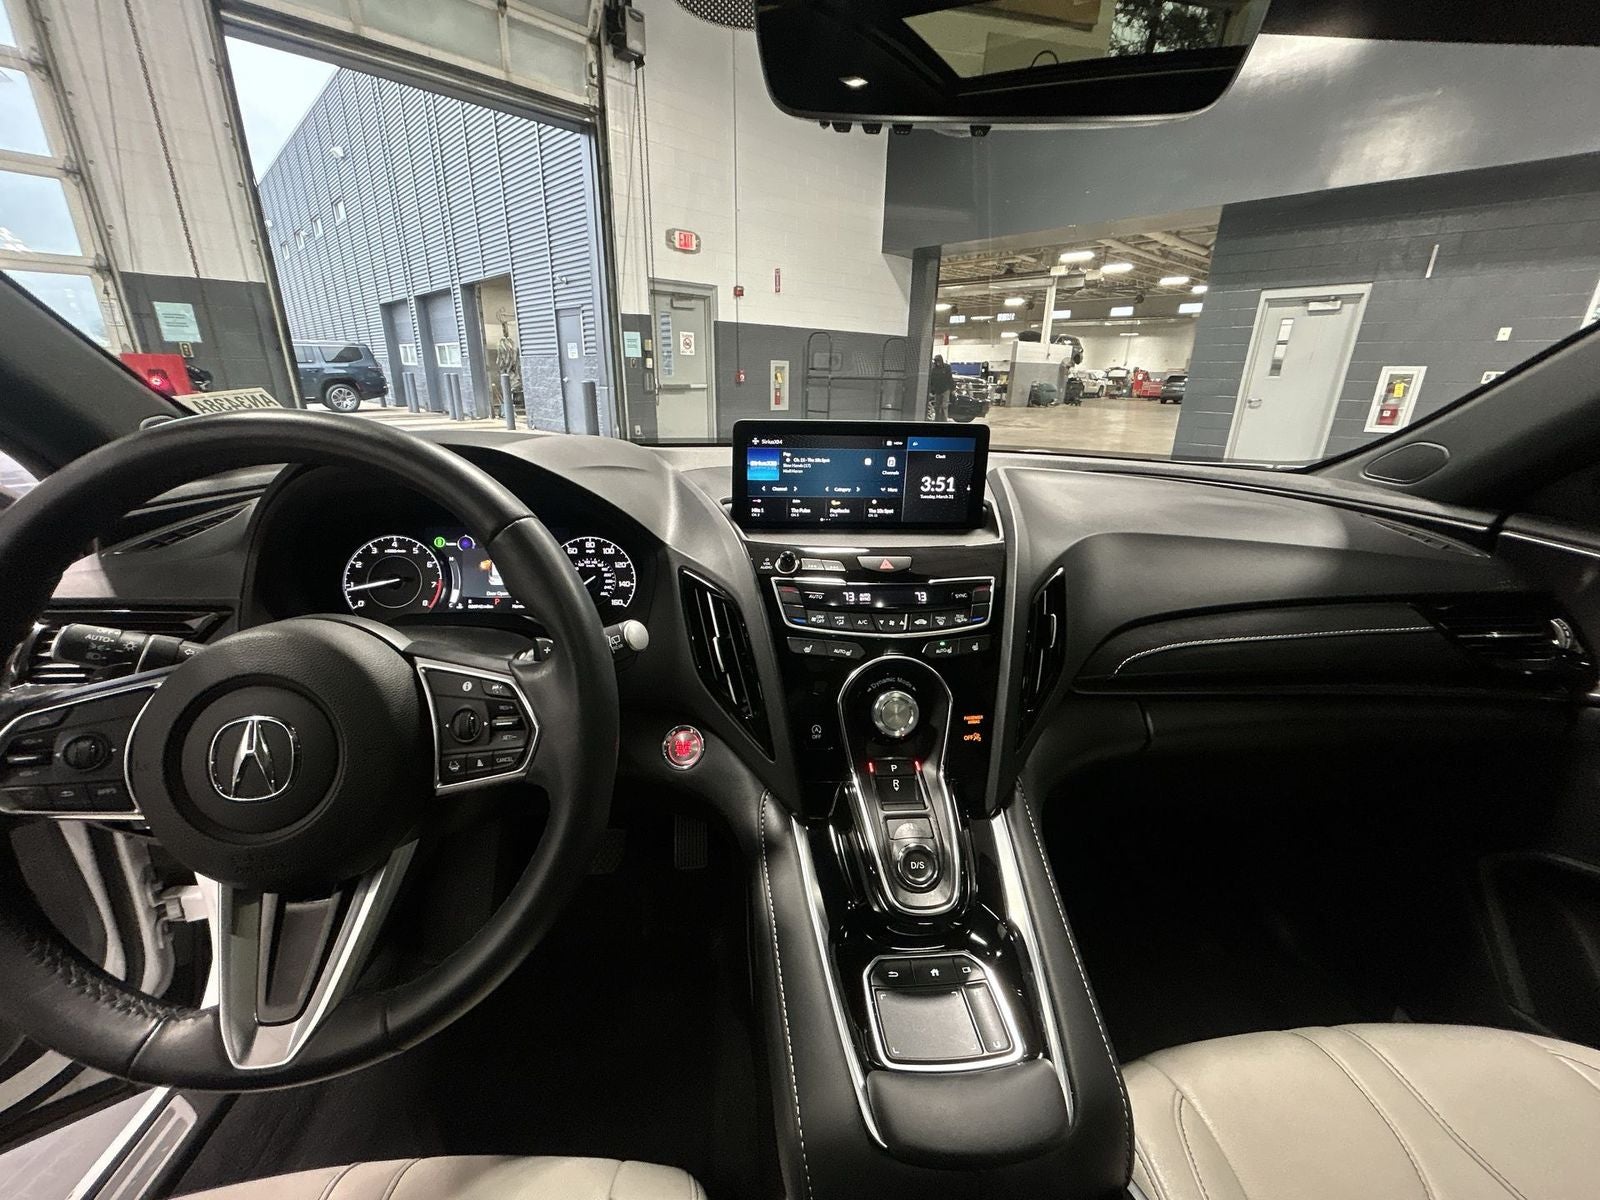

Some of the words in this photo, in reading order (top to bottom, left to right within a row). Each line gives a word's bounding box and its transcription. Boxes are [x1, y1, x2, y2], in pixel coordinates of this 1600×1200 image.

[920, 476, 955, 492] 3:51
[843, 592, 855, 602] 73
[914, 591, 927, 602] 73
[870, 677, 896, 689] Dynamic
[890, 764, 898, 772] P
[892, 779, 899, 787] R
[910, 861, 925, 870] D/S
